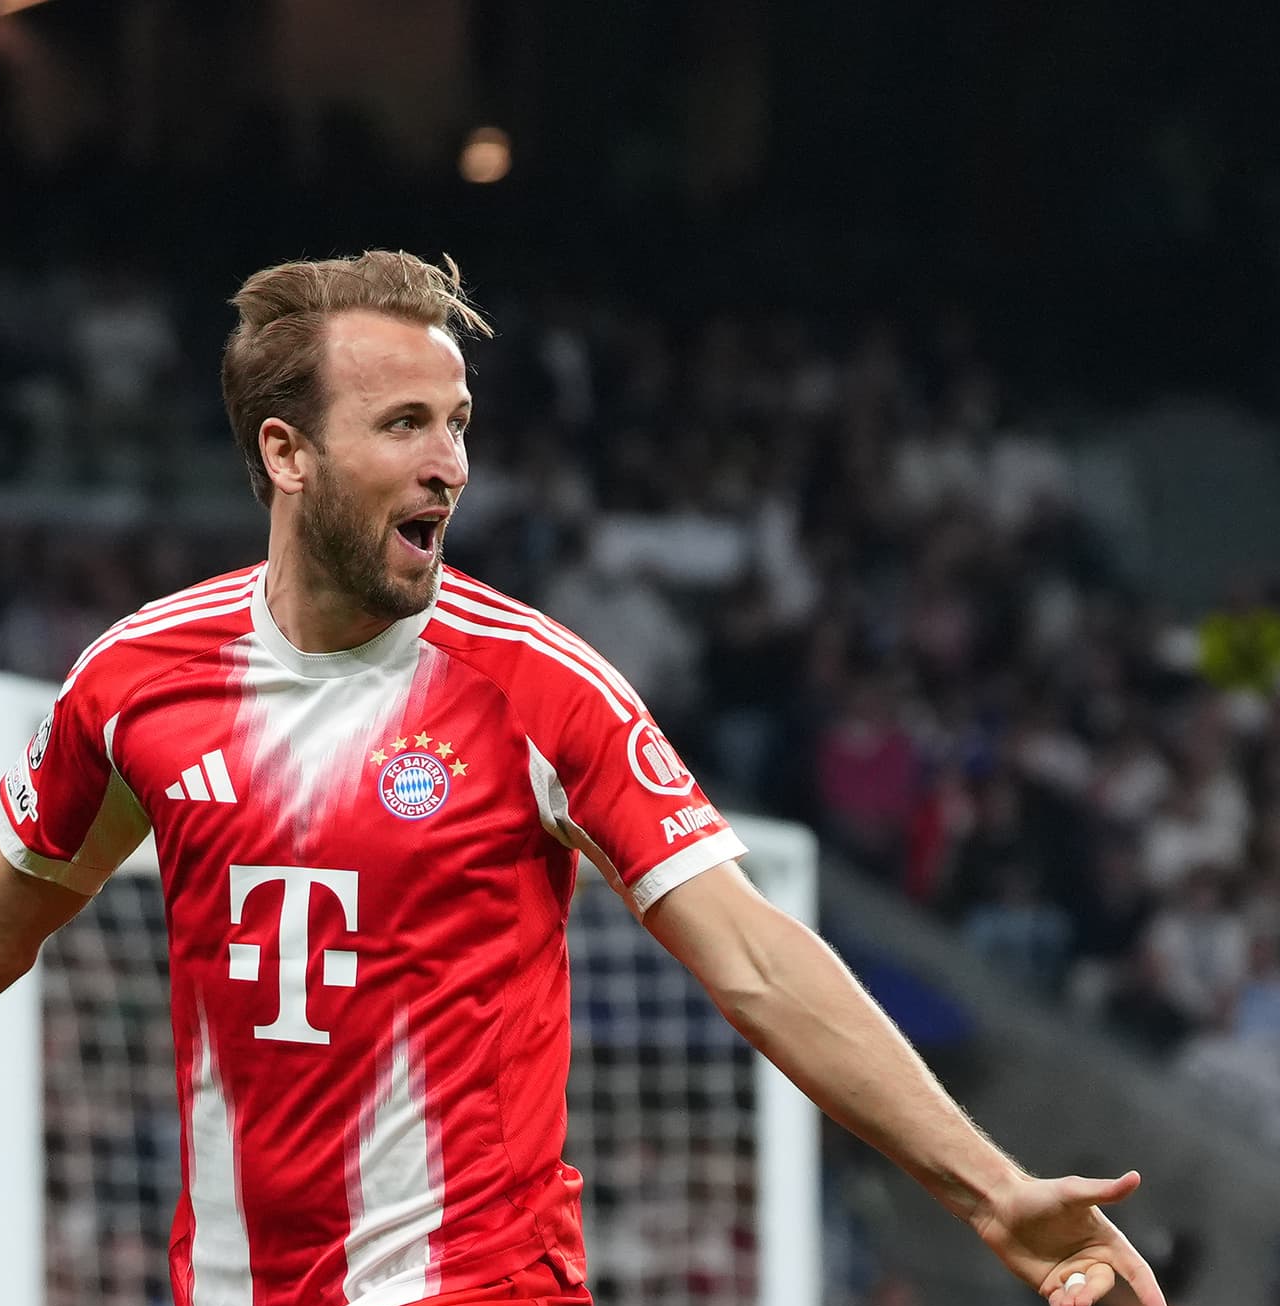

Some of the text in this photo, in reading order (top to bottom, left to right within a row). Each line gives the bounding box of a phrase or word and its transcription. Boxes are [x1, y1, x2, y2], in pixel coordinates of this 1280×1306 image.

[386, 757, 444, 785] FC BAYERN
[383, 788, 441, 815] MÜNCHEN
[228, 865, 360, 1045] T
